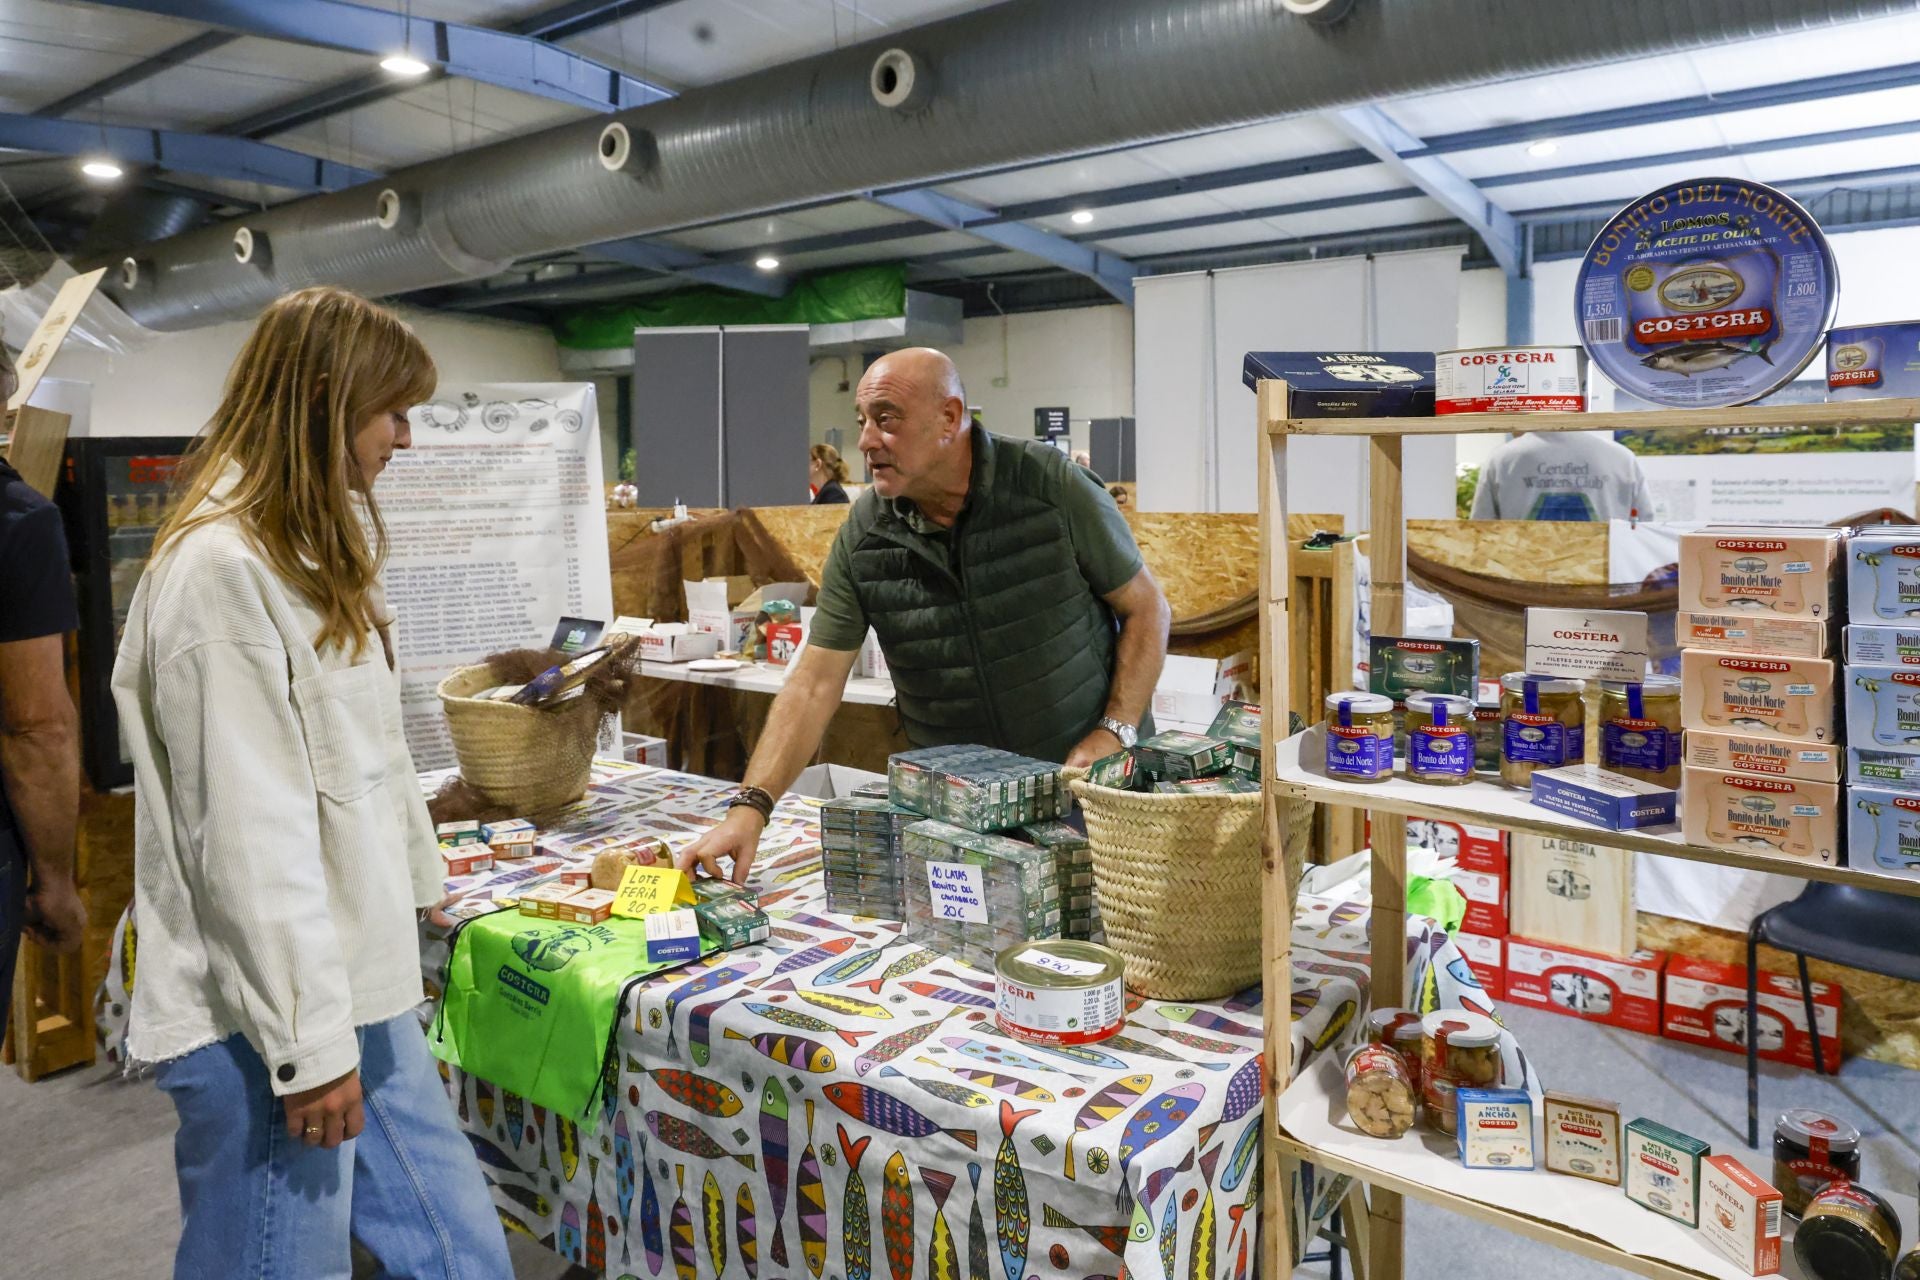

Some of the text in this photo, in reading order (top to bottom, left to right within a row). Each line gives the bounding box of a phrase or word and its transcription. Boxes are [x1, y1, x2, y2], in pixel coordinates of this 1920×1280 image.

[1593, 184, 1811, 266] BONITO DEL NORTE
[1660, 212, 1730, 232] LOMOS
[1635, 227, 1761, 251] EN ACEITE DE OLIVA
[1460, 353, 1556, 366] COSTERA
[1718, 540, 1784, 550] COSTERA
[1720, 574, 1782, 588] Bonito del Norte
[1898, 581, 1920, 594] Bonit
[1740, 588, 1772, 596] Natural
[1690, 614, 1738, 626] Bonito del Norte
[1554, 630, 1620, 642] COSTERA
[1896, 633, 1920, 646] Bonit
[1720, 659, 1788, 671] COSTERA
[1724, 694, 1786, 708] Bonito del Norte
[1744, 707, 1776, 716] Natural
[1728, 739, 1792, 758] Bonito del Norte
[1346, 754, 1354, 765] del
[1356, 756, 1372, 766] Norte
[1418, 753, 1464, 765] Bonito del Norte
[1724, 778, 1792, 791] COSTERA
[1557, 788, 1586, 802] COSTERA
[1630, 808, 1666, 818] COSTERA
[1728, 810, 1790, 828] Bonito del Norte
[1543, 839, 1596, 858] LA GLORIA
[944, 869, 968, 881] LATAS
[932, 880, 958, 892] BONITO
[627, 901, 647, 914] 20
[658, 946, 690, 955] COSTERA
[500, 968, 549, 1002] COSTERA
[1478, 1110, 1518, 1118] ANCHOA
[1558, 1113, 1604, 1128] SARDINA
[1642, 1144, 1678, 1164] BONITO
[1708, 1180, 1744, 1214] COSTERA
